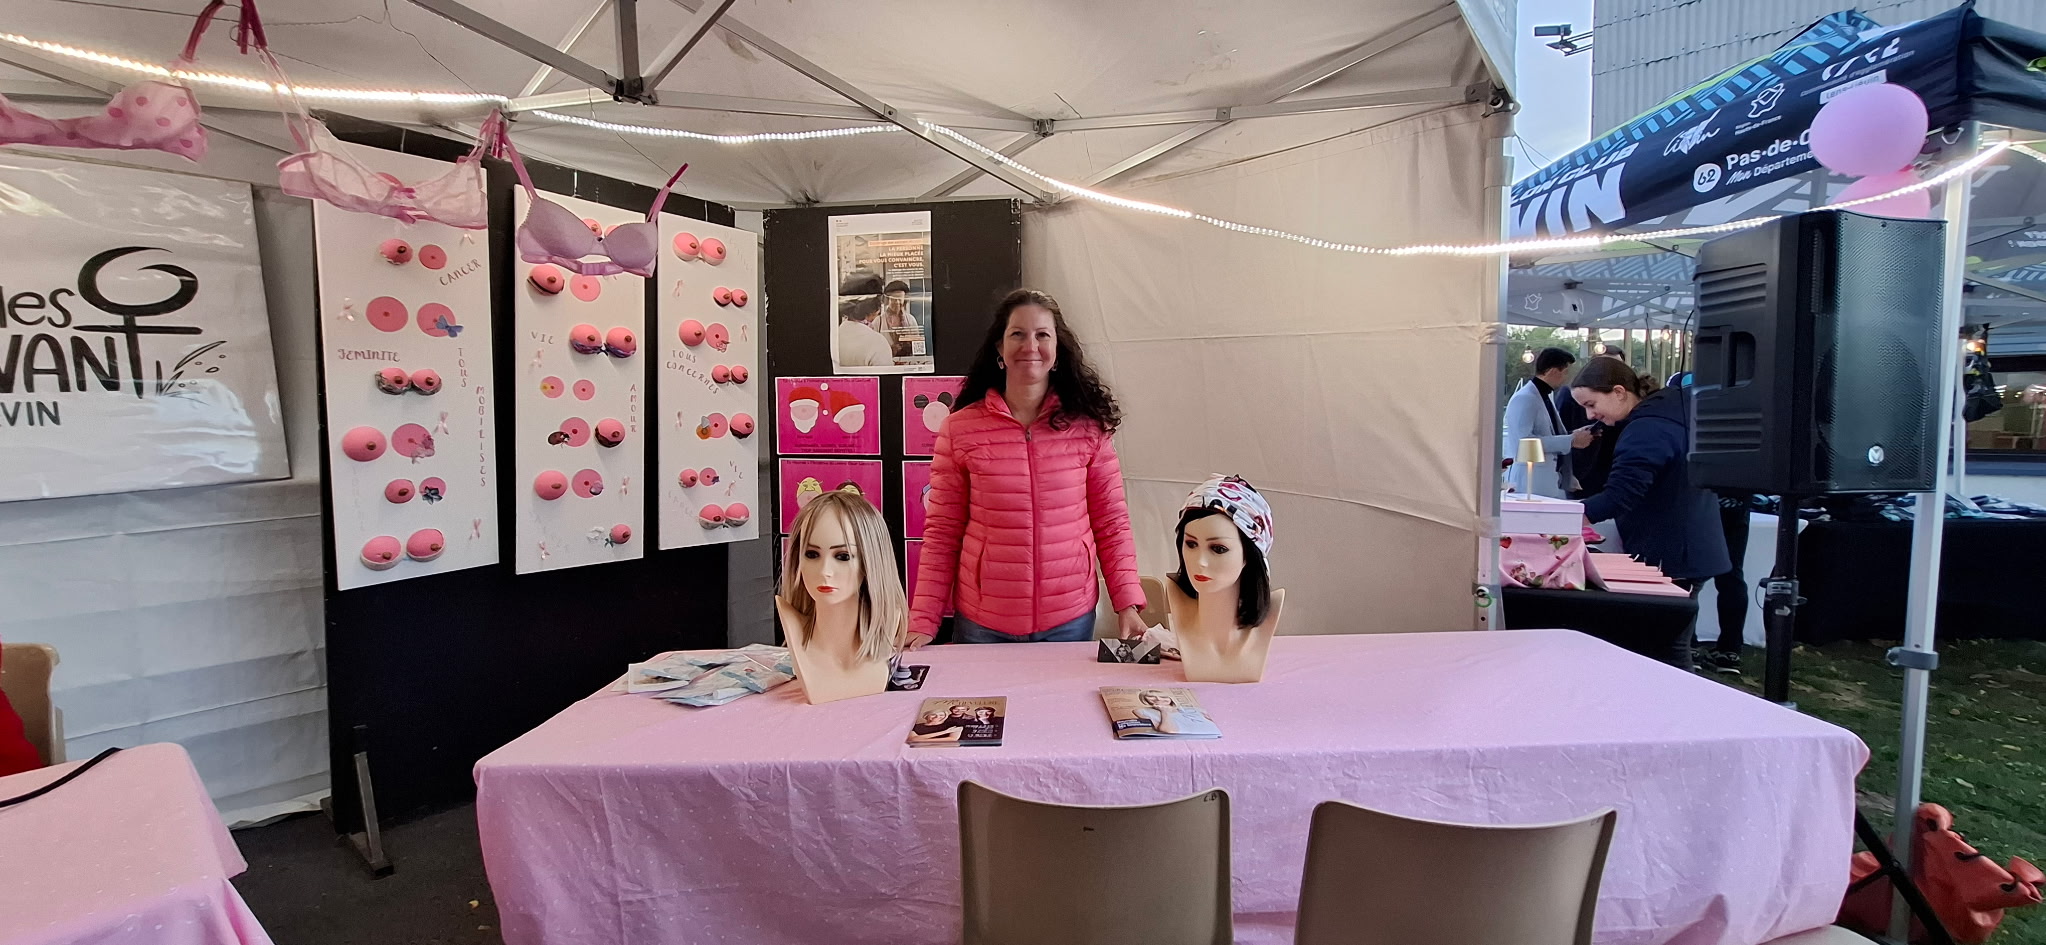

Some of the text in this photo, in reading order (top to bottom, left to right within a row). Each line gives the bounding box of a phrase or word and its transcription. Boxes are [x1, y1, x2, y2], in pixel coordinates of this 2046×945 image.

[1557, 142, 1640, 185] CLUB
[1697, 169, 1716, 185] 62
[1753, 151, 1814, 176] Départeme
[439, 258, 482, 286] CANCER
[458, 348, 468, 388] TOUS
[672, 349, 697, 363] TOUS
[476, 386, 487, 487] MOBILISES
